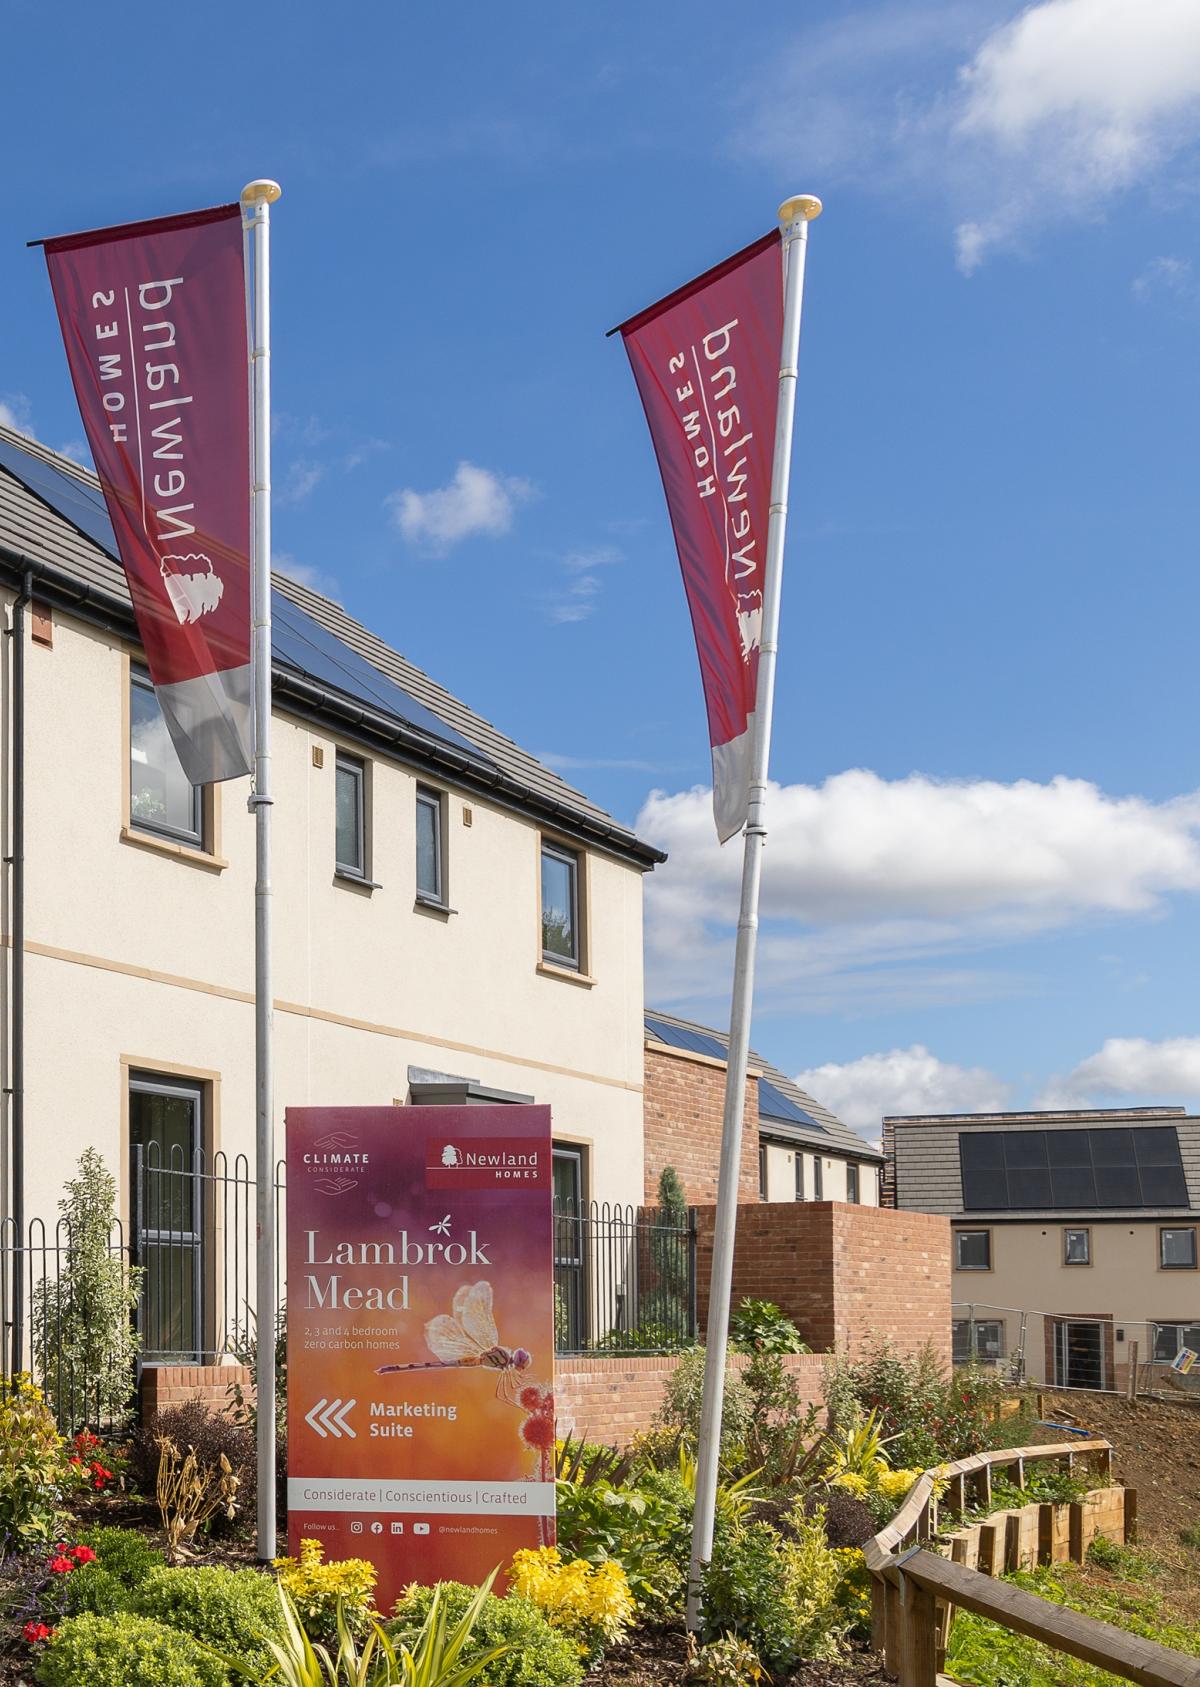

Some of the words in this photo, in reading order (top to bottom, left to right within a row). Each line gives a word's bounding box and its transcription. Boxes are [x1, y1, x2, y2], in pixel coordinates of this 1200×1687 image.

[303, 1153, 369, 1164] CLIMATE
[466, 1151, 538, 1166] Newland
[495, 1170, 538, 1179] HOMES
[303, 1230, 492, 1265] Lambrok
[303, 1275, 412, 1310] Mead
[304, 1327, 313, 1336] 2,
[314, 1327, 320, 1337] 3
[322, 1326, 341, 1336] and
[343, 1327, 350, 1337] 4
[352, 1325, 398, 1336] bedroom
[304, 1340, 326, 1349] zero
[328, 1339, 364, 1349] carbon
[366, 1340, 400, 1350] homes
[370, 1402, 457, 1420] Marketing
[370, 1423, 413, 1437] Suite
[303, 1489, 377, 1501] Considerate
[385, 1490, 473, 1504] Conscientious
[481, 1491, 528, 1505] Crafted
[303, 1522, 327, 1531] Follow
[438, 1526, 498, 1535] @newlandhomes
